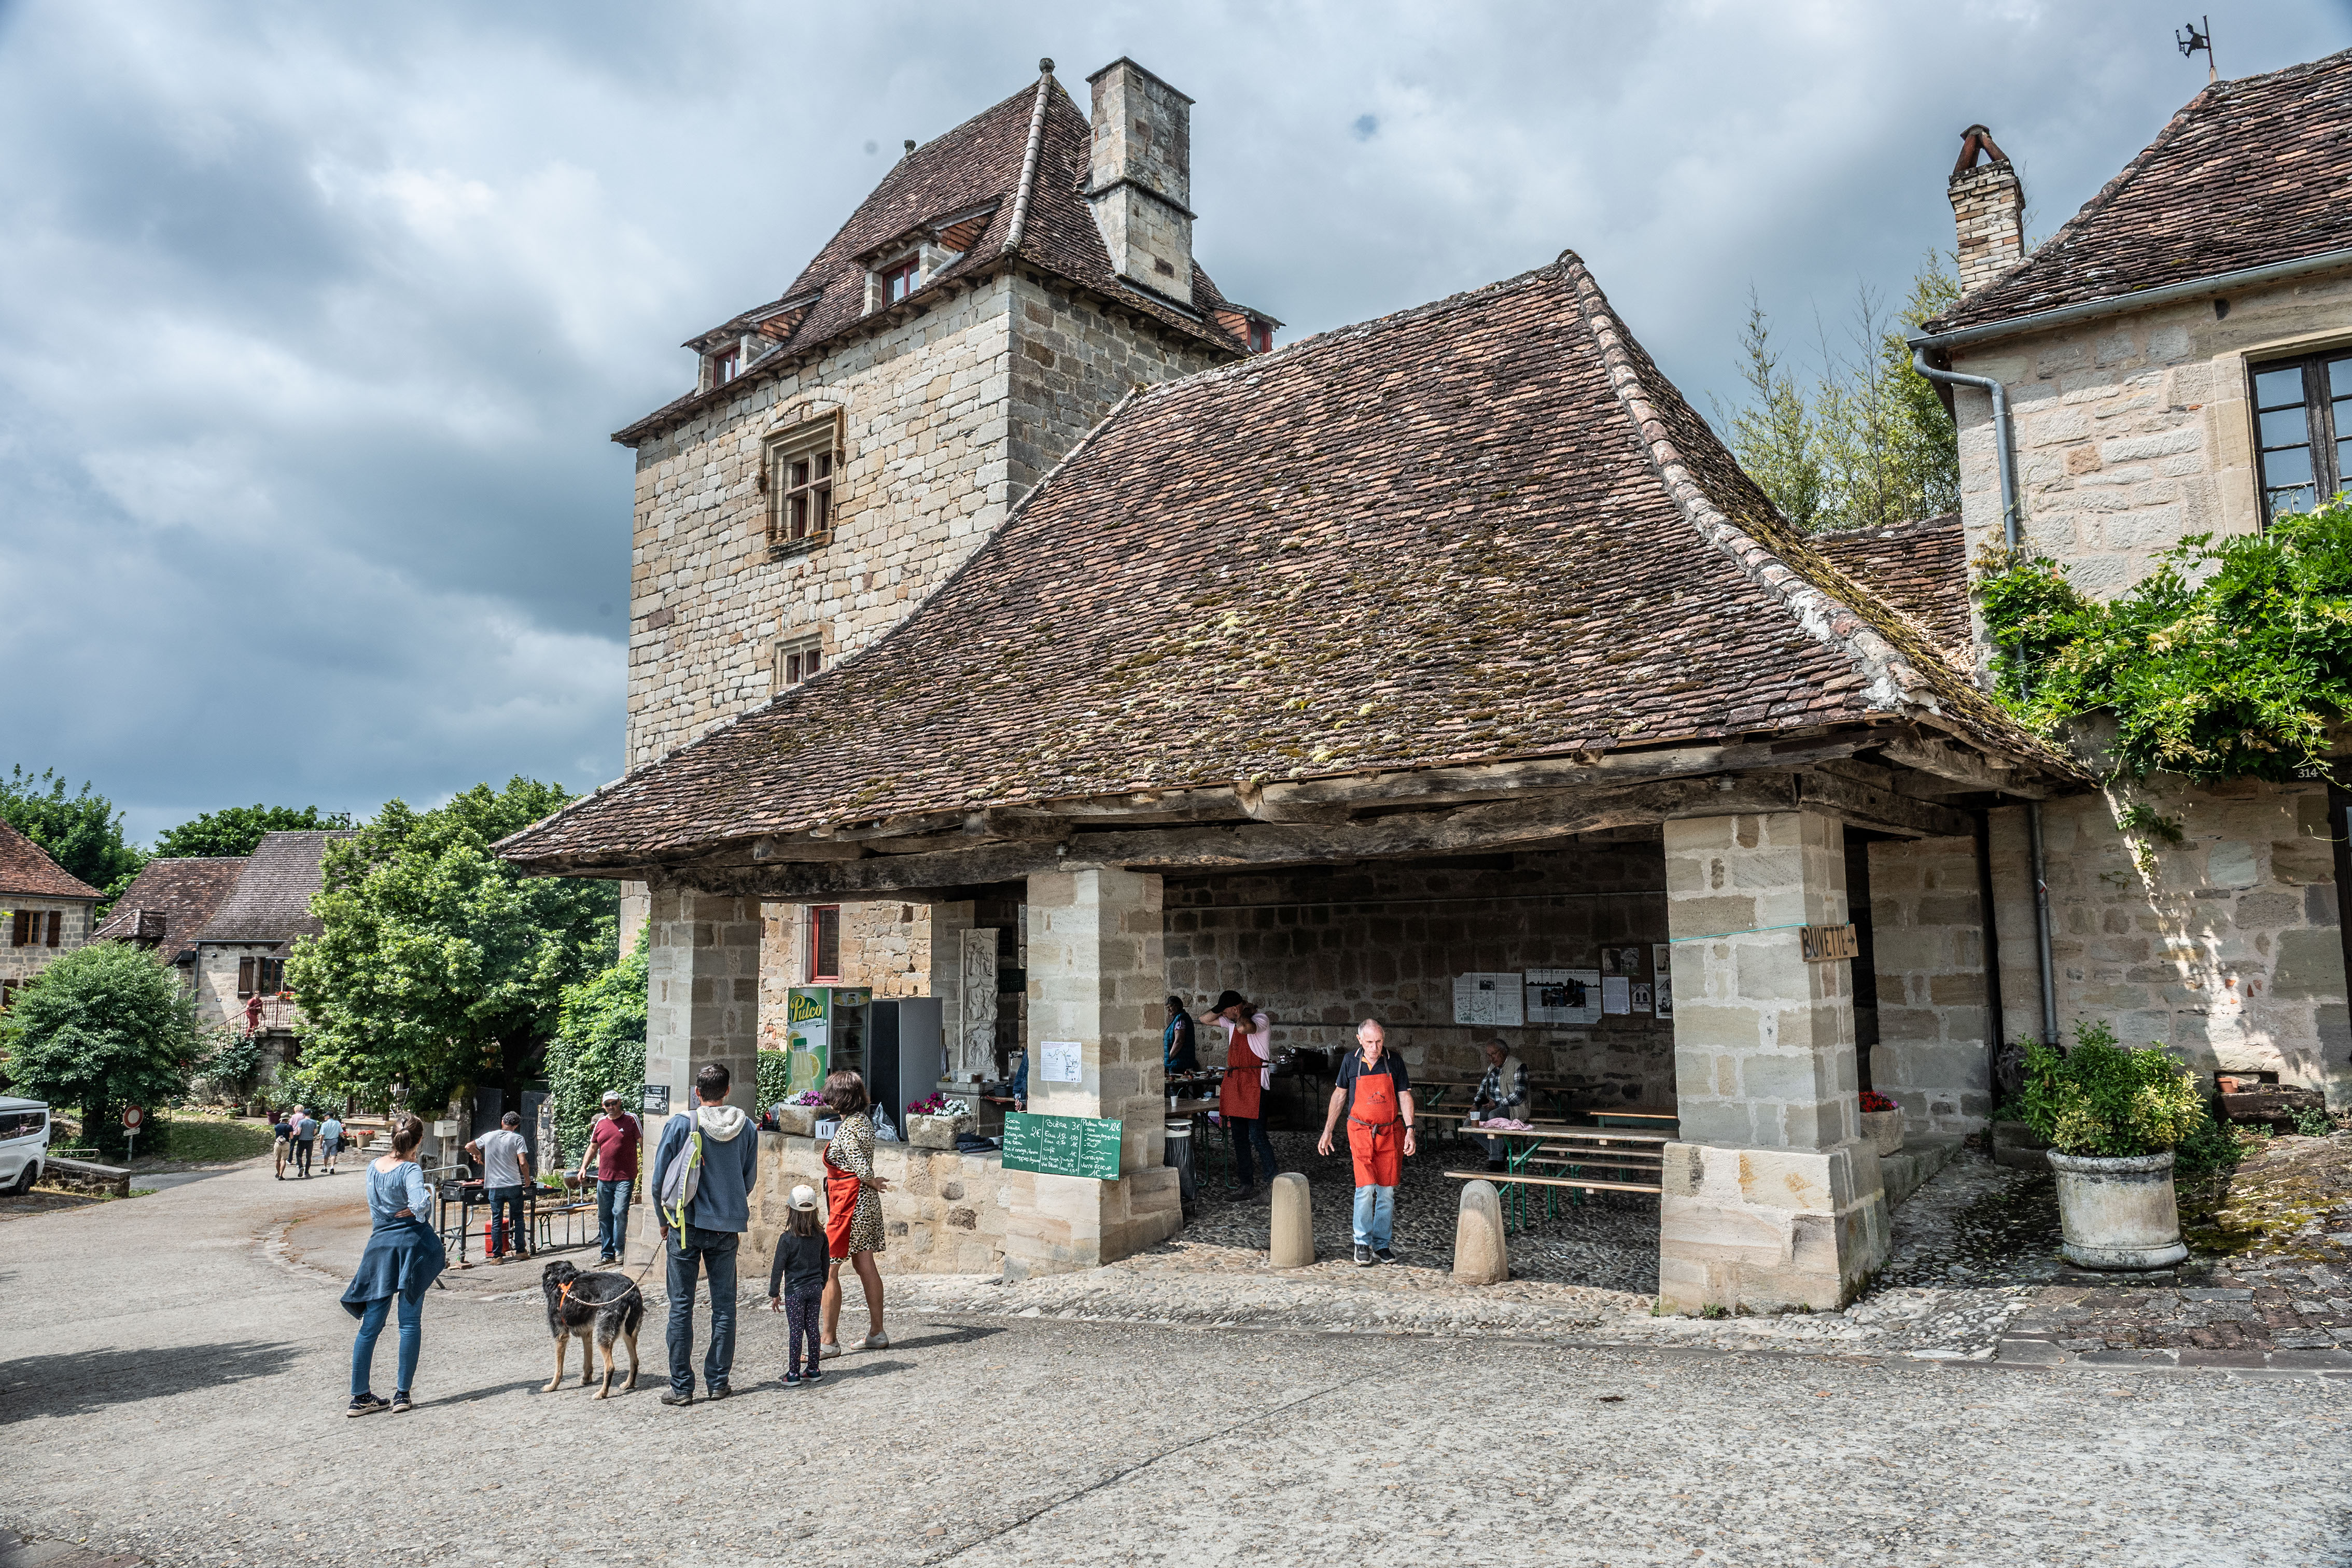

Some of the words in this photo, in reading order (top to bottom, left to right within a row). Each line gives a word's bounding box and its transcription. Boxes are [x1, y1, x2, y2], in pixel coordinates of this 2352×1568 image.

[2298, 768, 2318, 778] 314
[1801, 926, 1848, 958] BUVETTE
[790, 995, 822, 1023] Pulco
[1045, 1119, 1067, 1128] Bière
[1072, 1122, 1080, 1130] 3€
[1109, 1123, 1121, 1131] 12€
[1030, 1126, 1041, 1138] 2€
[1081, 1154, 1104, 1163] Consigne
